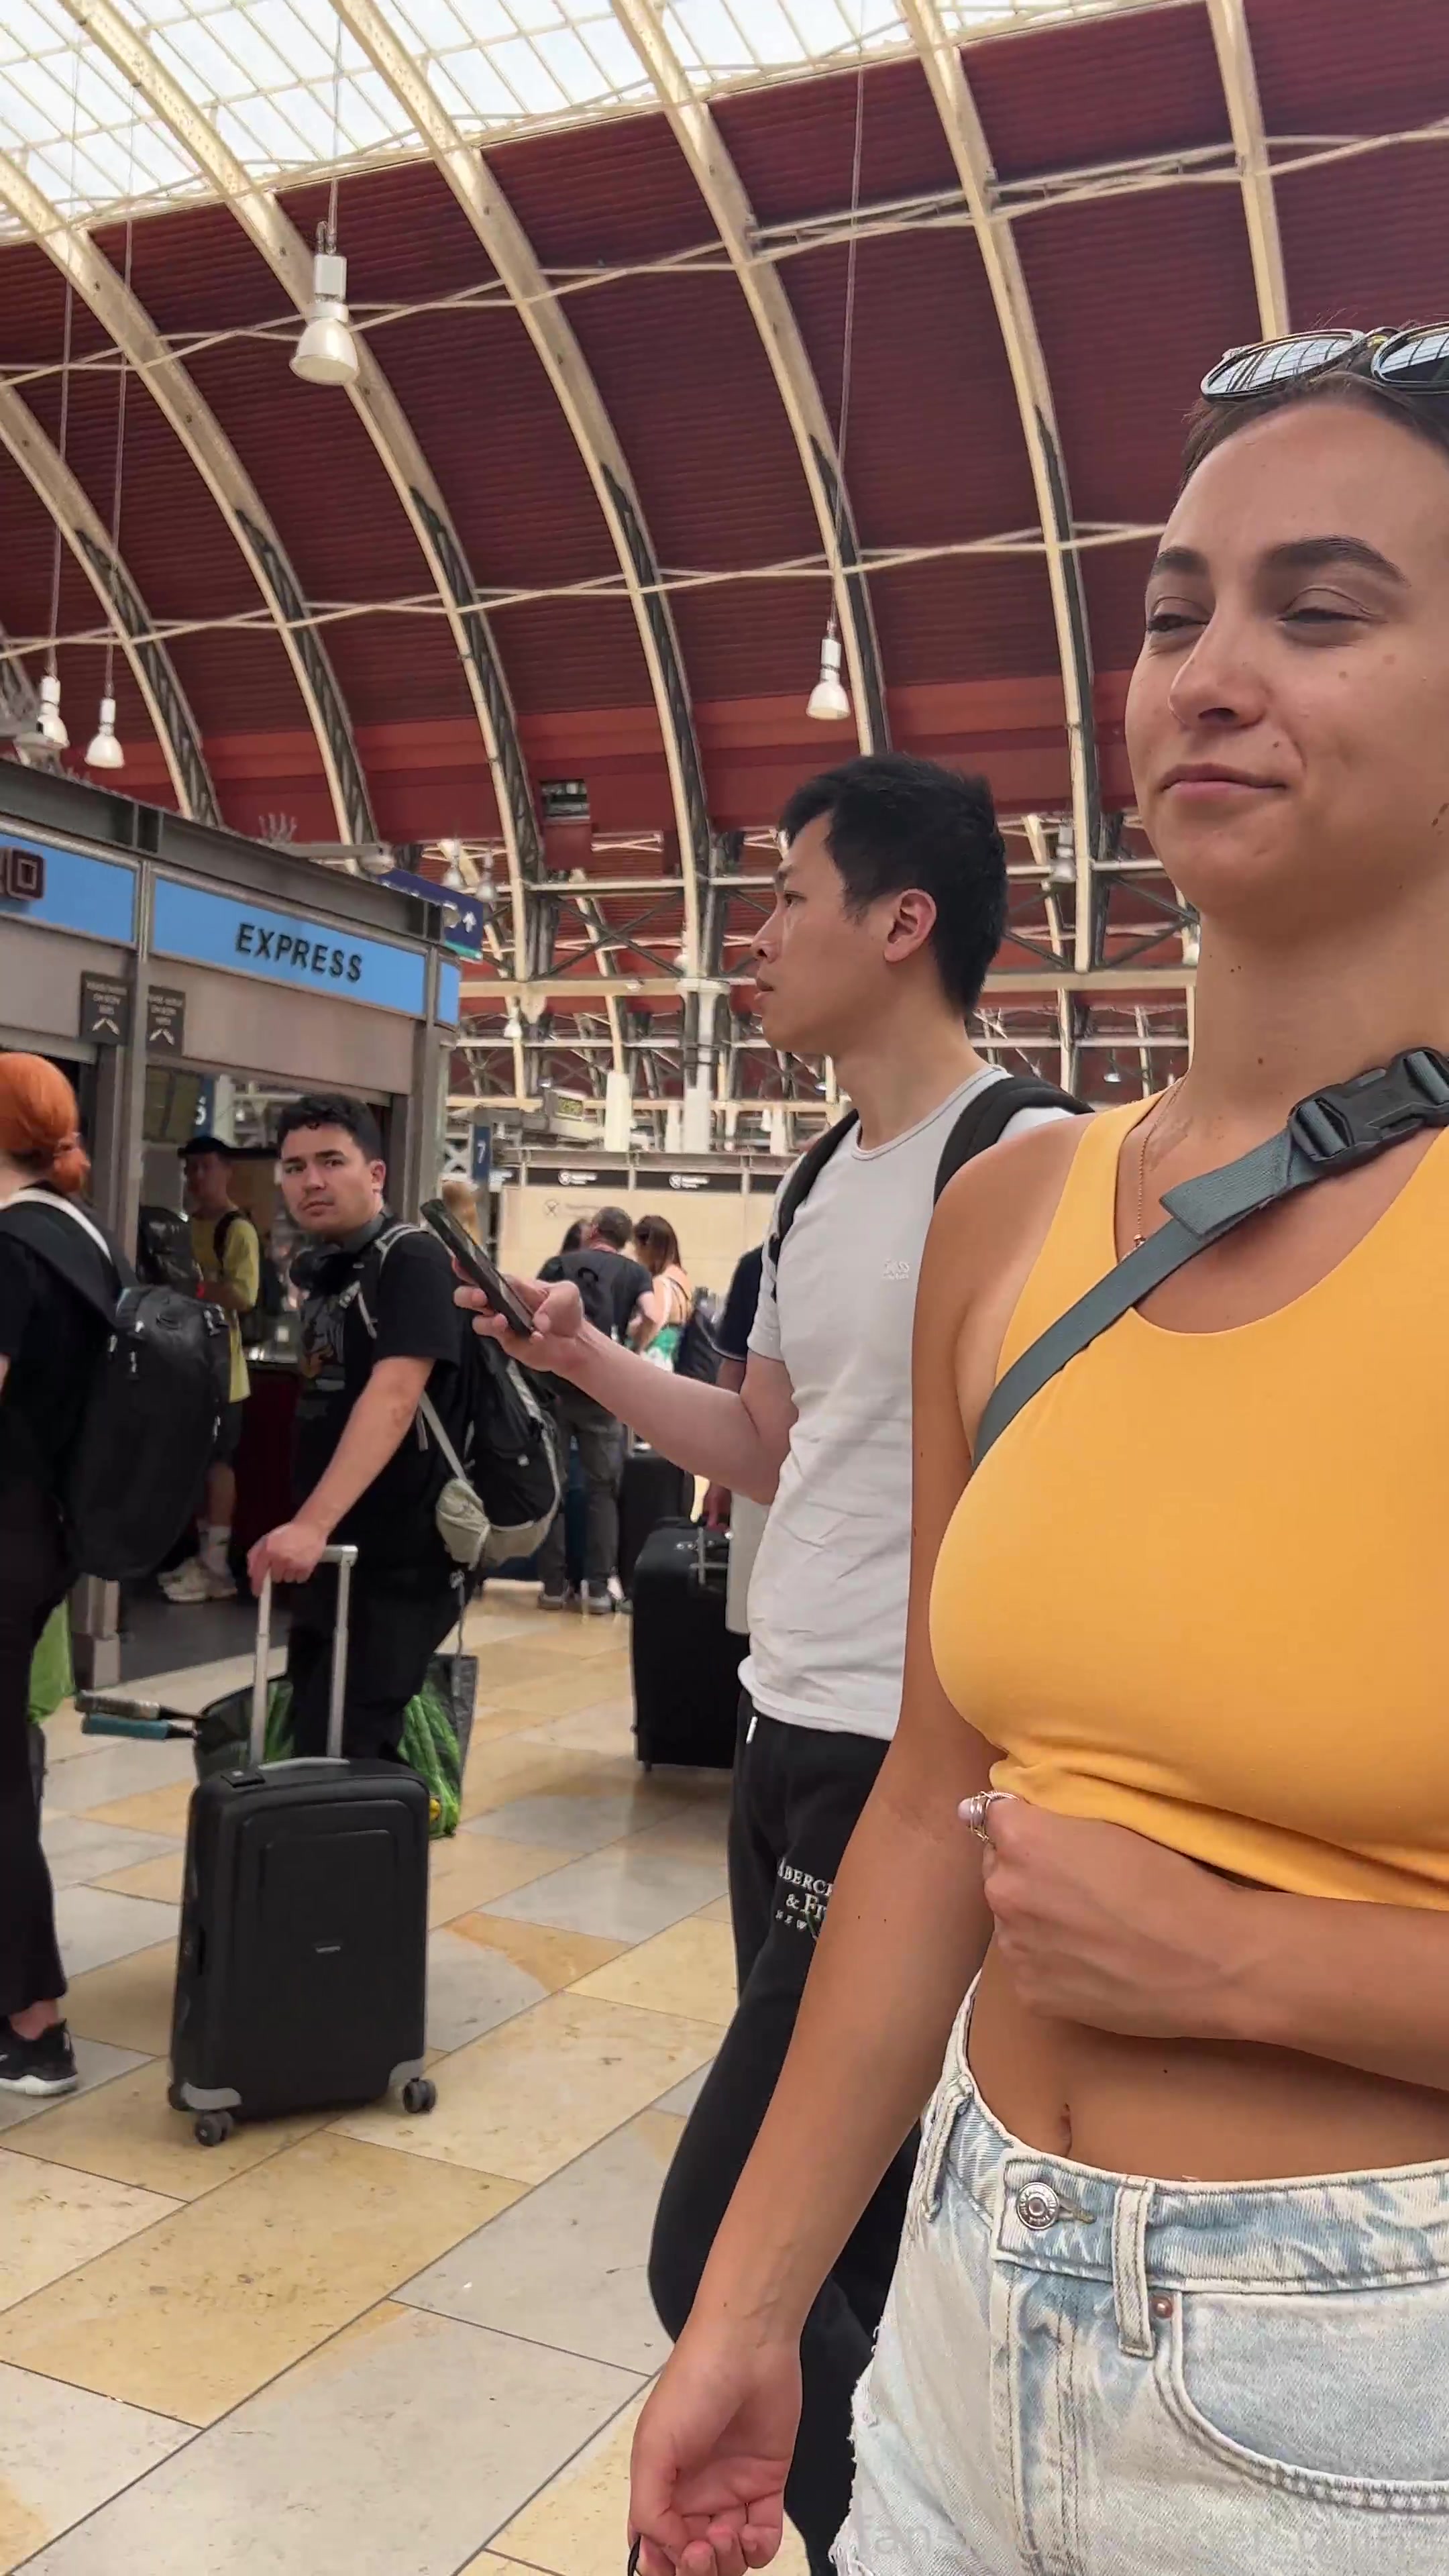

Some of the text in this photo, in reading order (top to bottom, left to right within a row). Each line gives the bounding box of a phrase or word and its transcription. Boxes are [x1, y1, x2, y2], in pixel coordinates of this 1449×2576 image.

[235, 922, 363, 982] EXPRESS
[477, 1140, 486, 1163] 7
[786, 1893, 800, 1910] &
